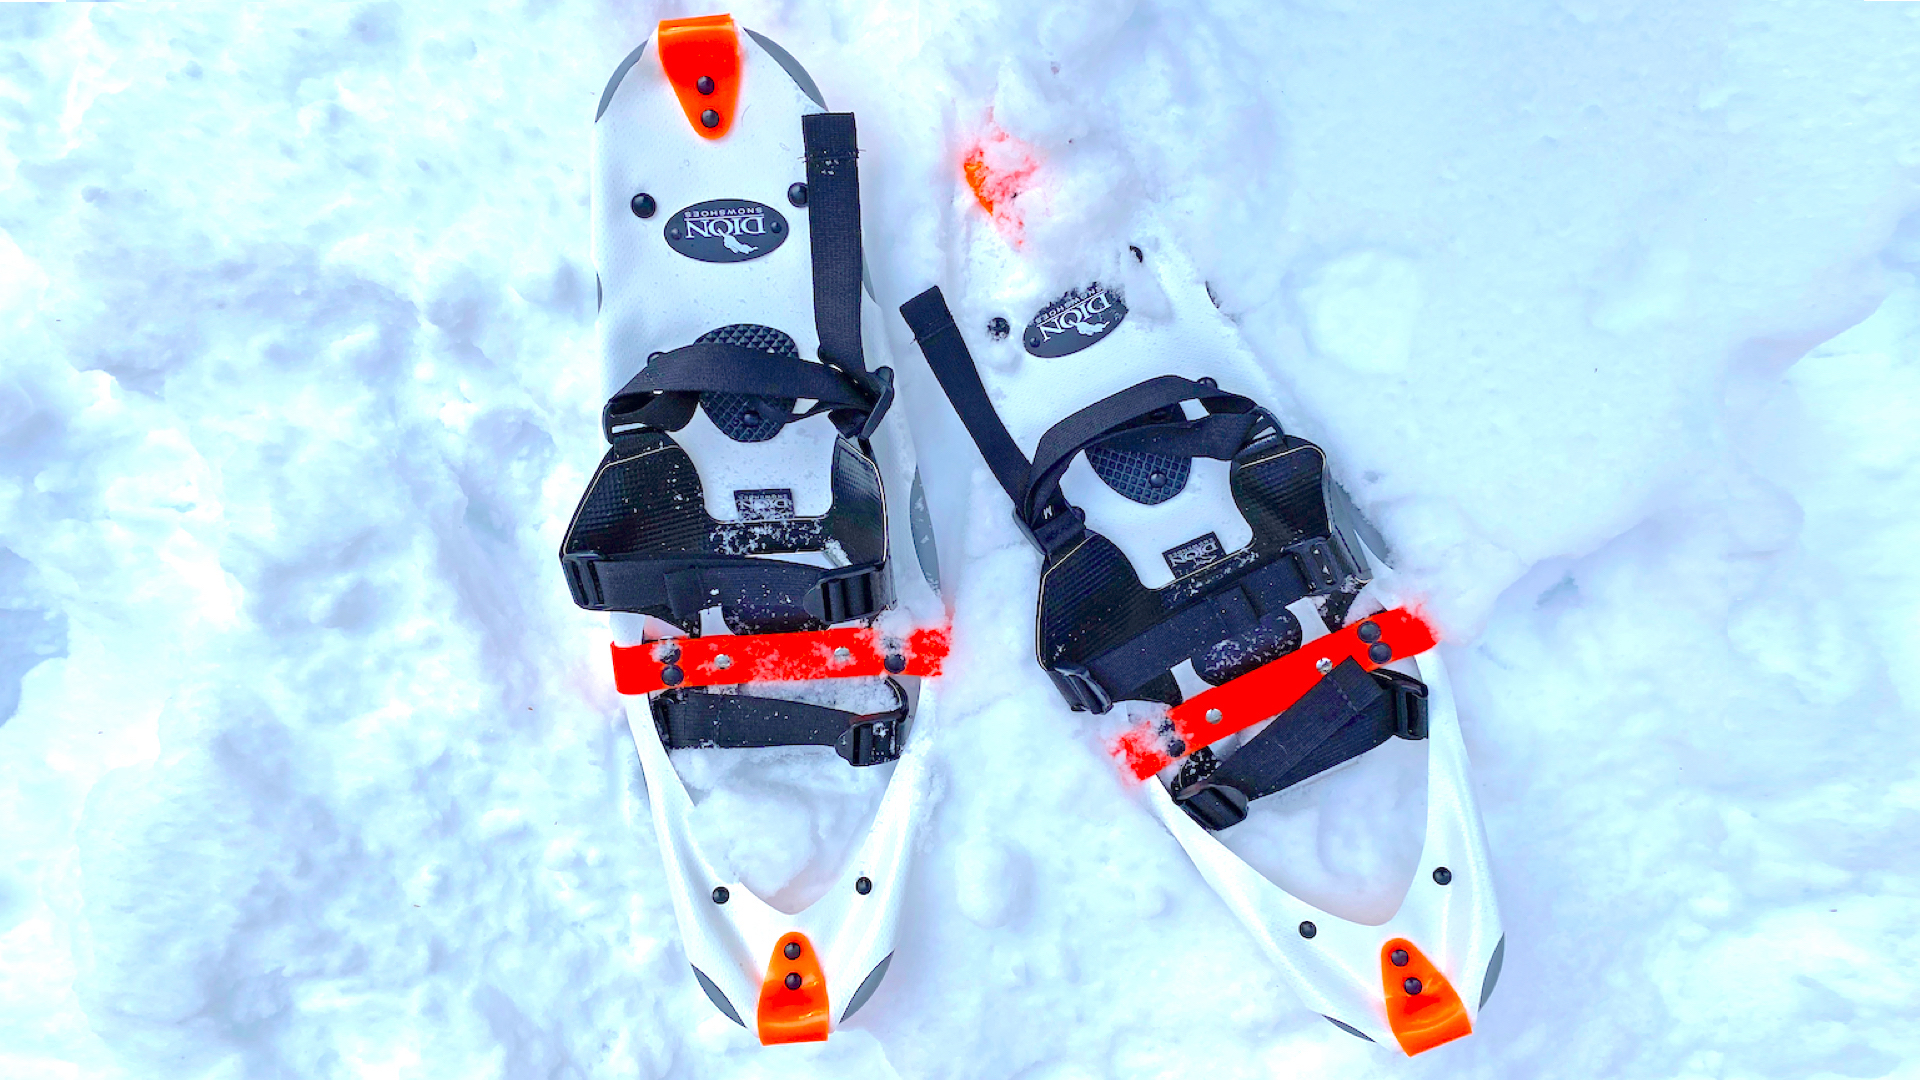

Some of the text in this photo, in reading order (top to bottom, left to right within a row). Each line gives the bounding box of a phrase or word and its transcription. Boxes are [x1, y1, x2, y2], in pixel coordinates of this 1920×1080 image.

[684, 207, 763, 218] SNOWSHOES
[684, 216, 766, 239] DION
[1039, 293, 1111, 342] DION
[1169, 543, 1218, 567] DION
